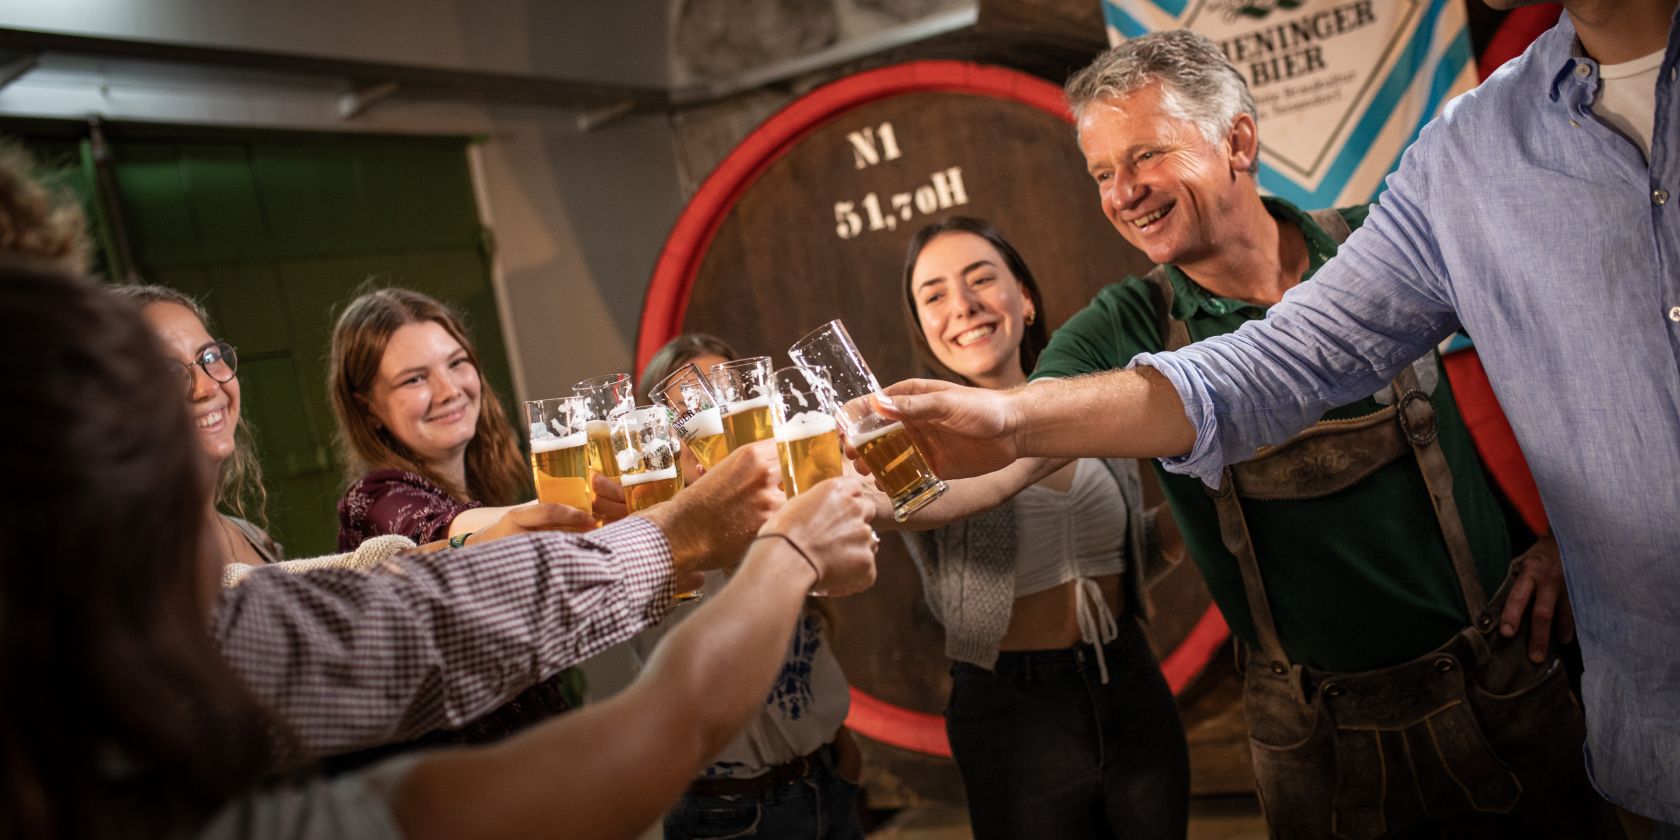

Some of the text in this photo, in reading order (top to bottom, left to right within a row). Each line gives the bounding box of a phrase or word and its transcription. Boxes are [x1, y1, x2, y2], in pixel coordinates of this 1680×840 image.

[1220, 1, 1376, 62] IENINGER
[1250, 46, 1327, 88] BIER
[846, 122, 902, 170] N1
